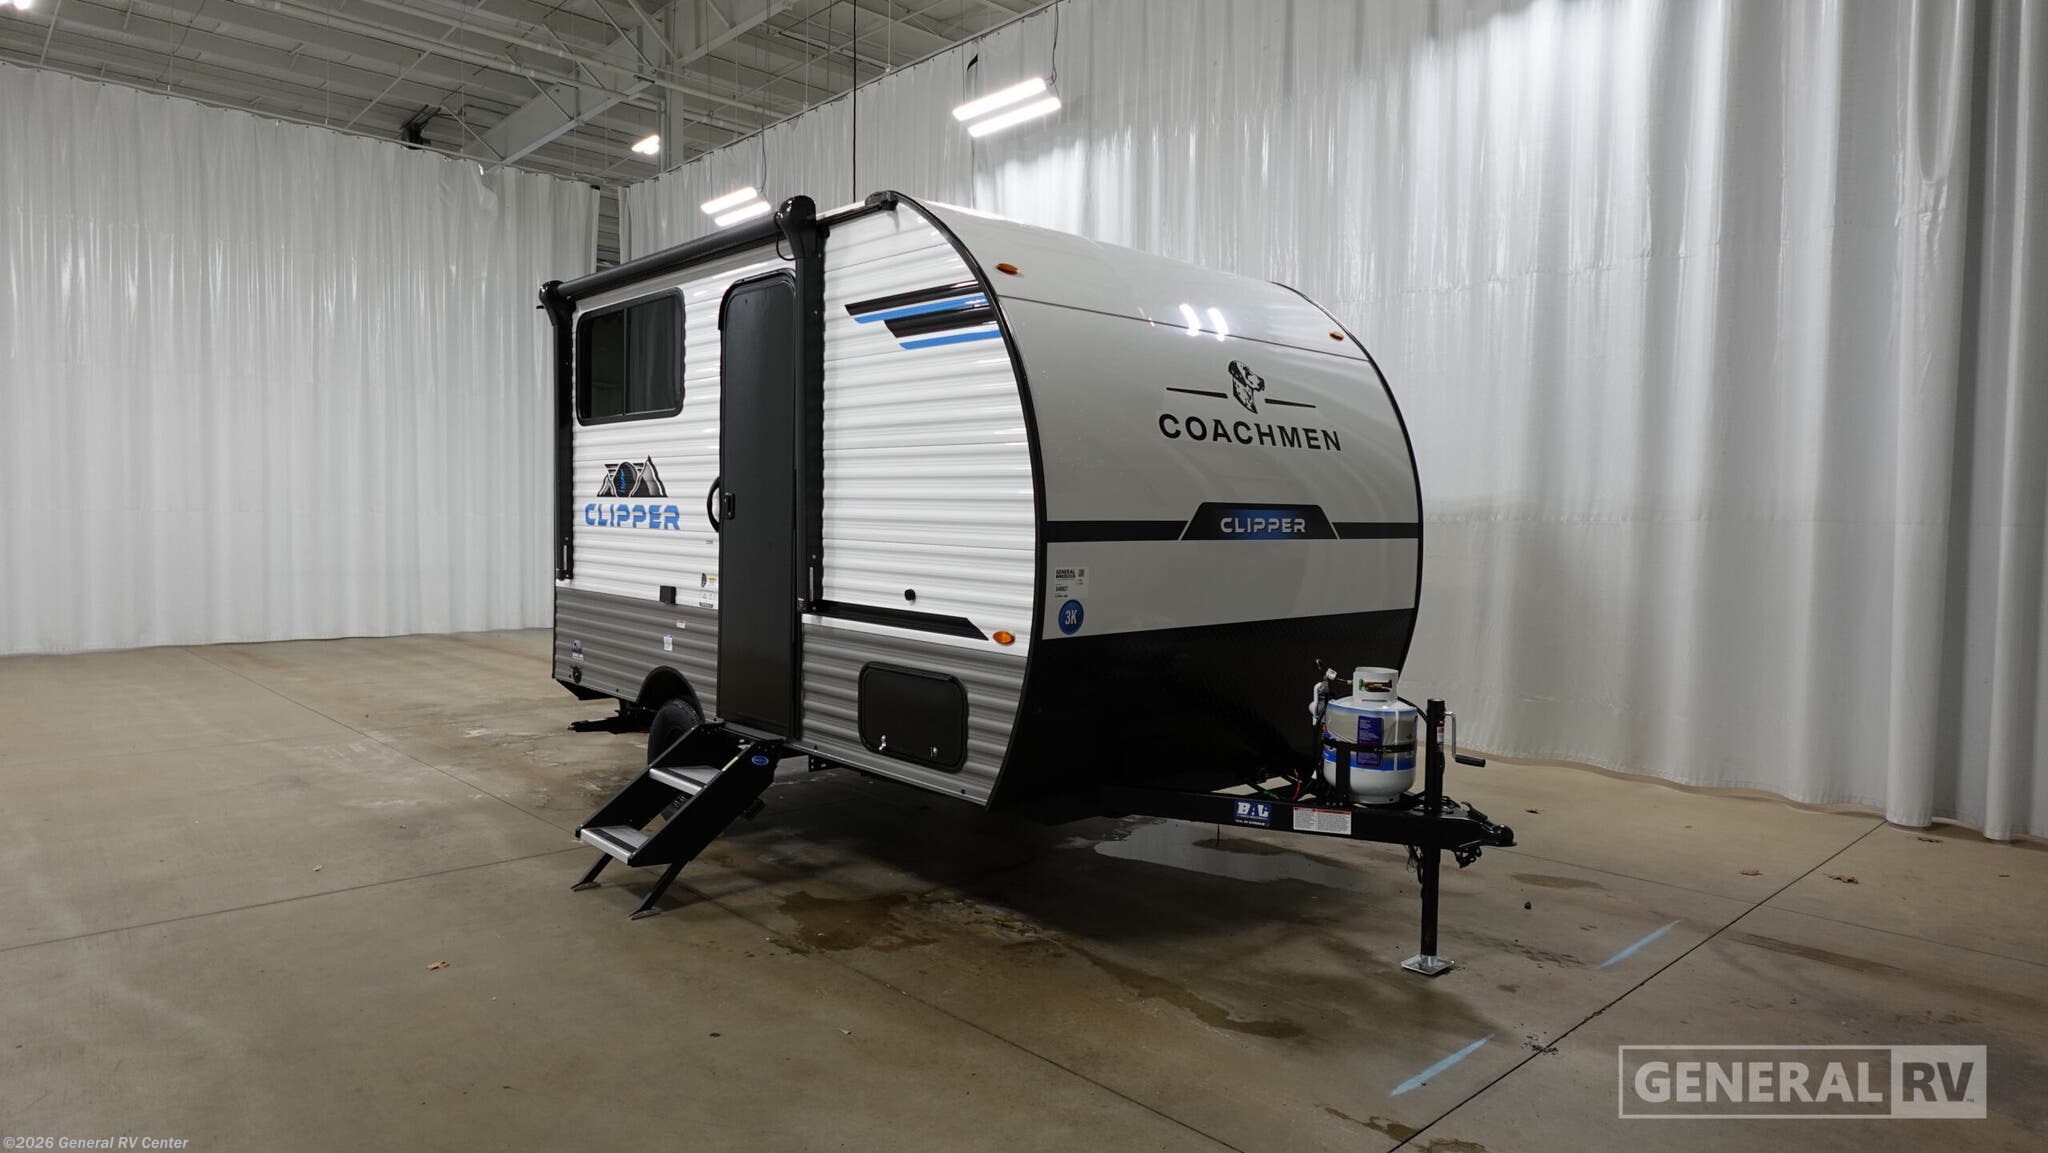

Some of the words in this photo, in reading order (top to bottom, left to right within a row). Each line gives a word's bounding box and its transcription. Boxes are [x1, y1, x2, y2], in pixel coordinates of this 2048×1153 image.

[1158, 412, 1342, 452] COACHMEN
[584, 503, 681, 530] CLIPPER
[1219, 516, 1307, 534] CLIPPER
[1064, 609, 1078, 626] 3K
